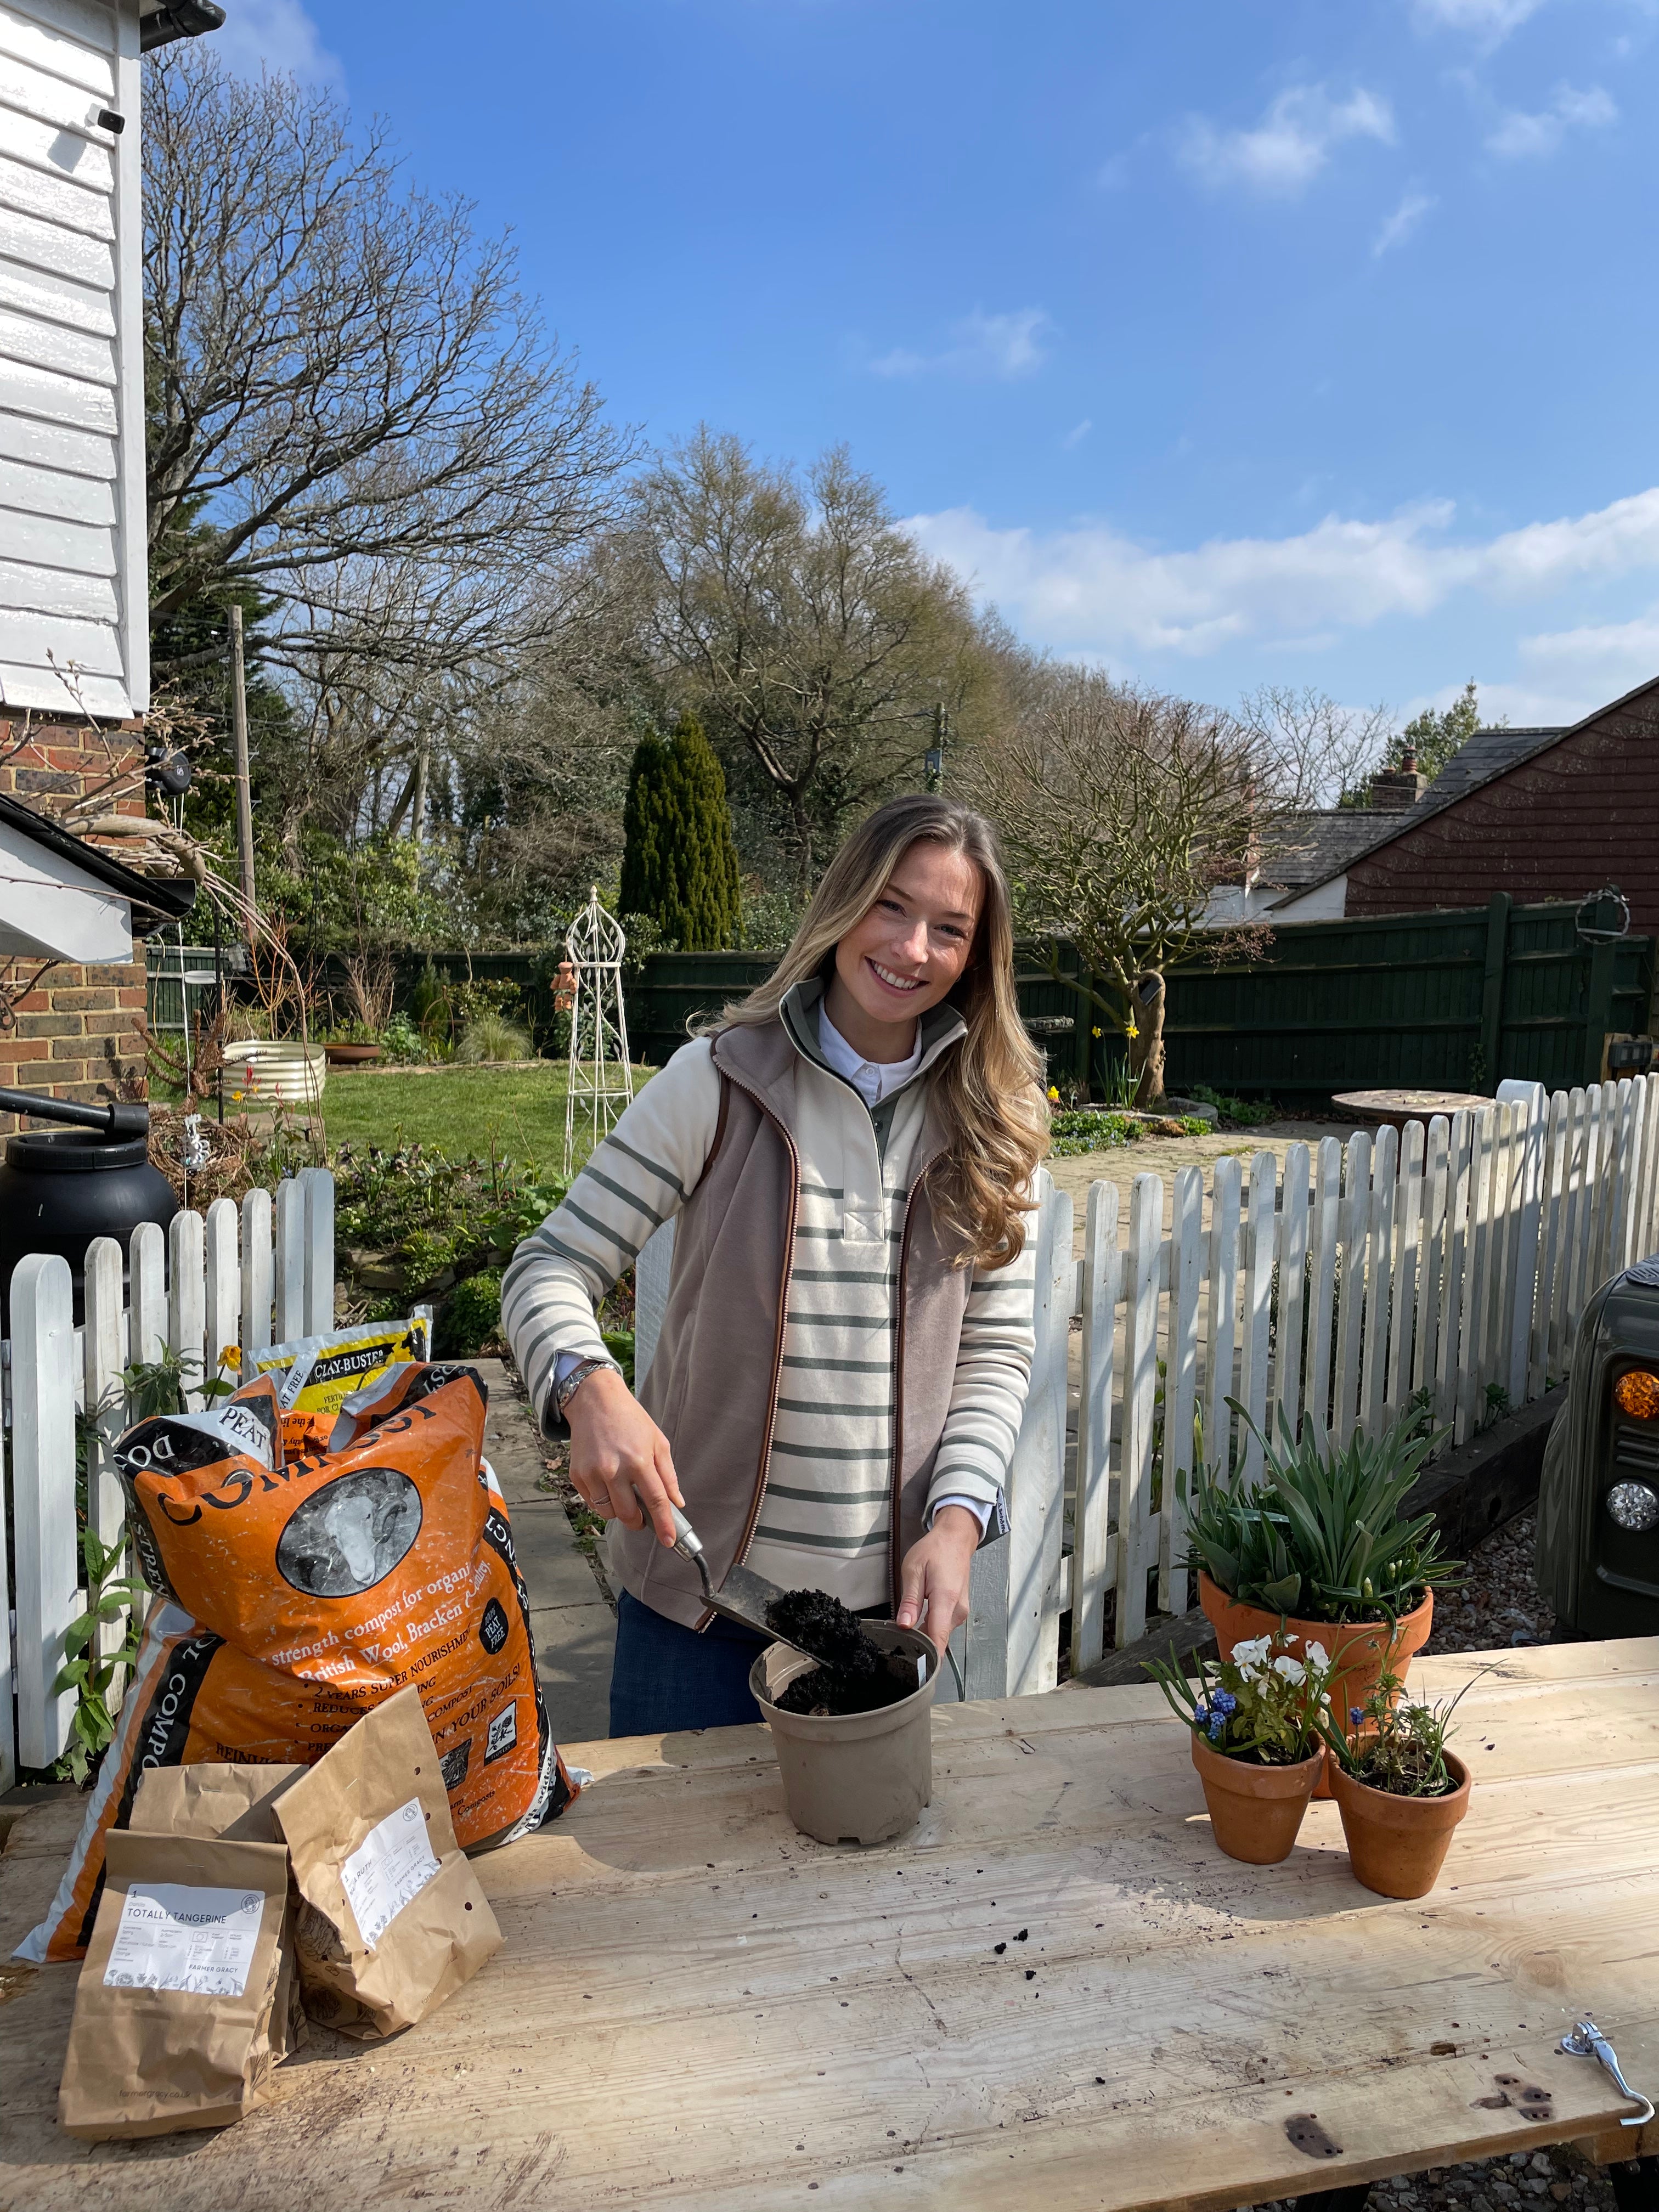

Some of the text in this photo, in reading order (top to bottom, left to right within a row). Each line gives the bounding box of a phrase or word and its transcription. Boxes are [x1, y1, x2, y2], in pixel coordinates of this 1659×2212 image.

[287, 1370, 304, 1394] FREE
[218, 1406, 267, 1450] PEAT
[292, 1418, 306, 1427] the
[272, 1632, 340, 1667] strength
[345, 1600, 401, 1639] compost
[402, 1590, 423, 1610] for
[484, 1617, 501, 1639] PEAT
[490, 1628, 505, 1649] FREE
[299, 1655, 356, 1683] British
[359, 1633, 408, 1666] Wool,
[406, 1604, 462, 1644] Bracken
[314, 1687, 323, 1698] 2
[327, 1686, 367, 1700] YEARS
[370, 1671, 408, 1695] SUPER
[452, 1698, 487, 1731] YOUR
[490, 1663, 521, 1701] SOILS!
[313, 1702, 375, 1716] REDUCES
[427, 1684, 474, 1723] COMPOST
[450, 1790, 495, 1816] arm Composts
[394, 1870, 411, 1888] FARMER
[410, 1855, 426, 1871] GRACY
[131, 1890, 137, 1898] 1
[128, 1908, 227, 1924] TOTALLY TANGERINE
[189, 1964, 214, 1973] FARMER
